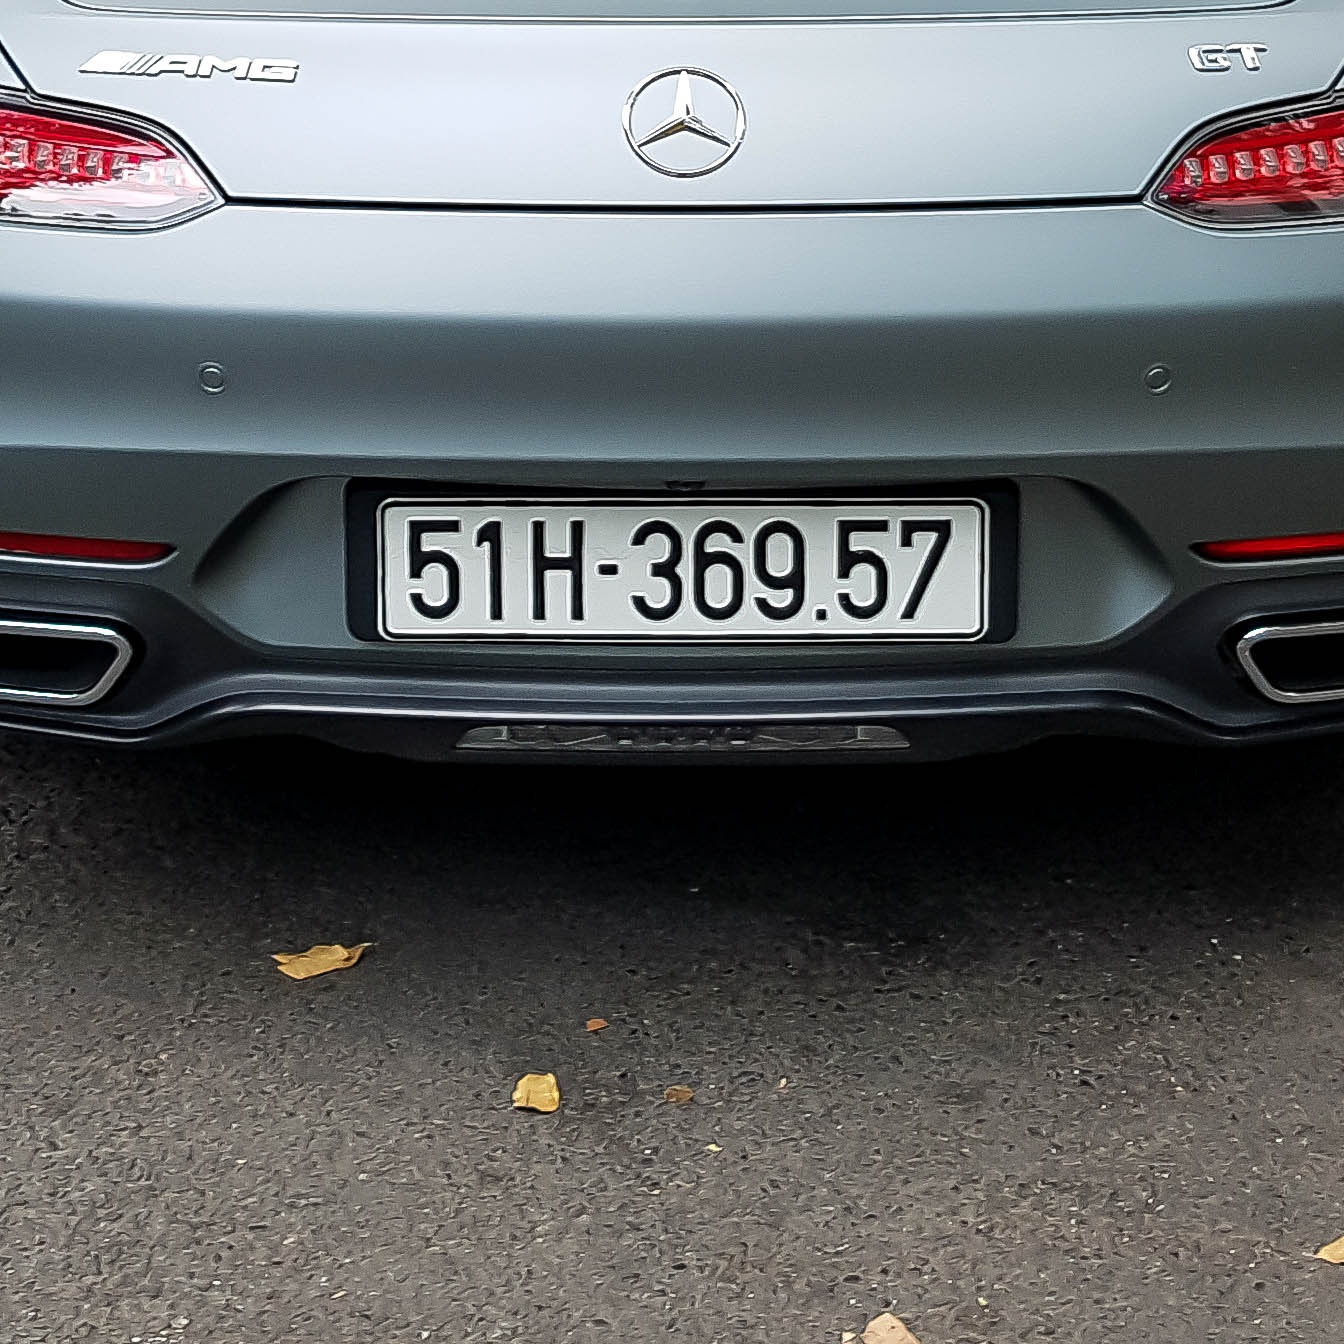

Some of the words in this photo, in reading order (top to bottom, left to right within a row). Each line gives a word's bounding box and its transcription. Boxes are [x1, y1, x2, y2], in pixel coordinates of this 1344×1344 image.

[145, 53, 300, 84] AMG
[1187, 43, 1268, 73] GT
[408, 519, 954, 622] 51H-369.57
